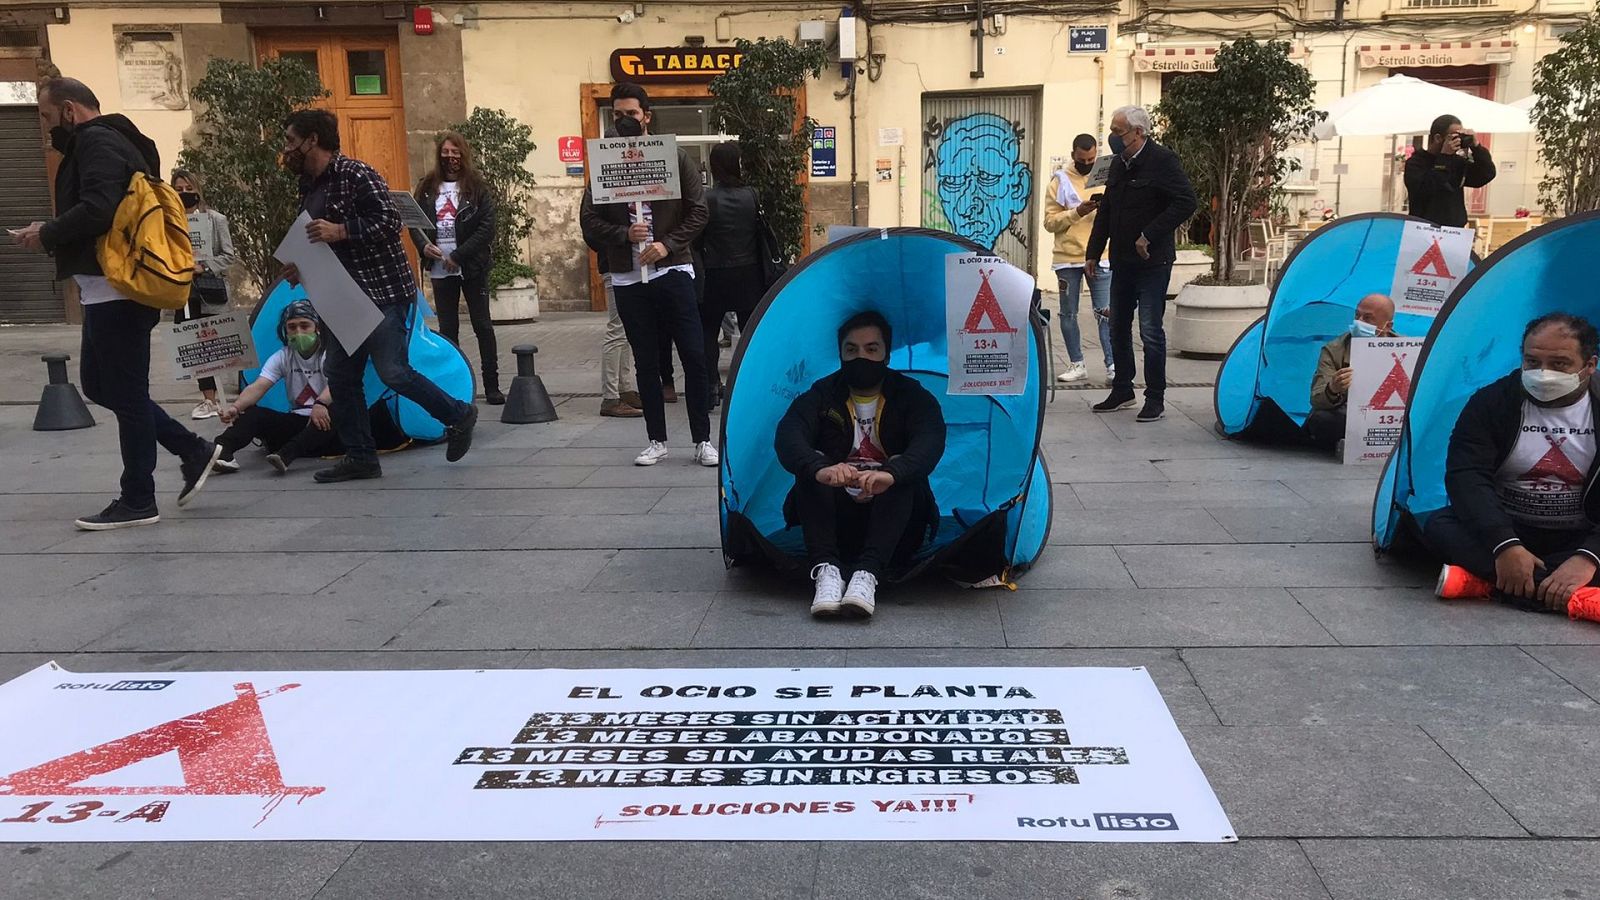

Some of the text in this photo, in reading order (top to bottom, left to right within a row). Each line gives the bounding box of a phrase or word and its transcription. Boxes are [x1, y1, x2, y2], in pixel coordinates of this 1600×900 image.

[1152, 60, 1190, 70] Estrella
[1378, 54, 1452, 66] Estrella Galicia
[1416, 279, 1437, 287] 13-A
[182, 323, 198, 332] OCIO
[210, 317, 235, 326] PLANTA
[974, 340, 998, 349] 13-A
[568, 684, 1036, 699] EL OCIO SE PLANTA
[542, 711, 1049, 726] 13 MESES SIN ACTIVIDAD
[526, 729, 1054, 743] 13 MESES ABANDONADOS
[460, 748, 1117, 763] 13 MESES SIN AYUDAS REALES
[507, 768, 1056, 784] 13 MESES SIN INGRESOS
[0, 800, 171, 822] 13-A
[618, 798, 958, 816] SOLUCIONES YA!!!
[1017, 814, 1173, 830] Rotu listo
